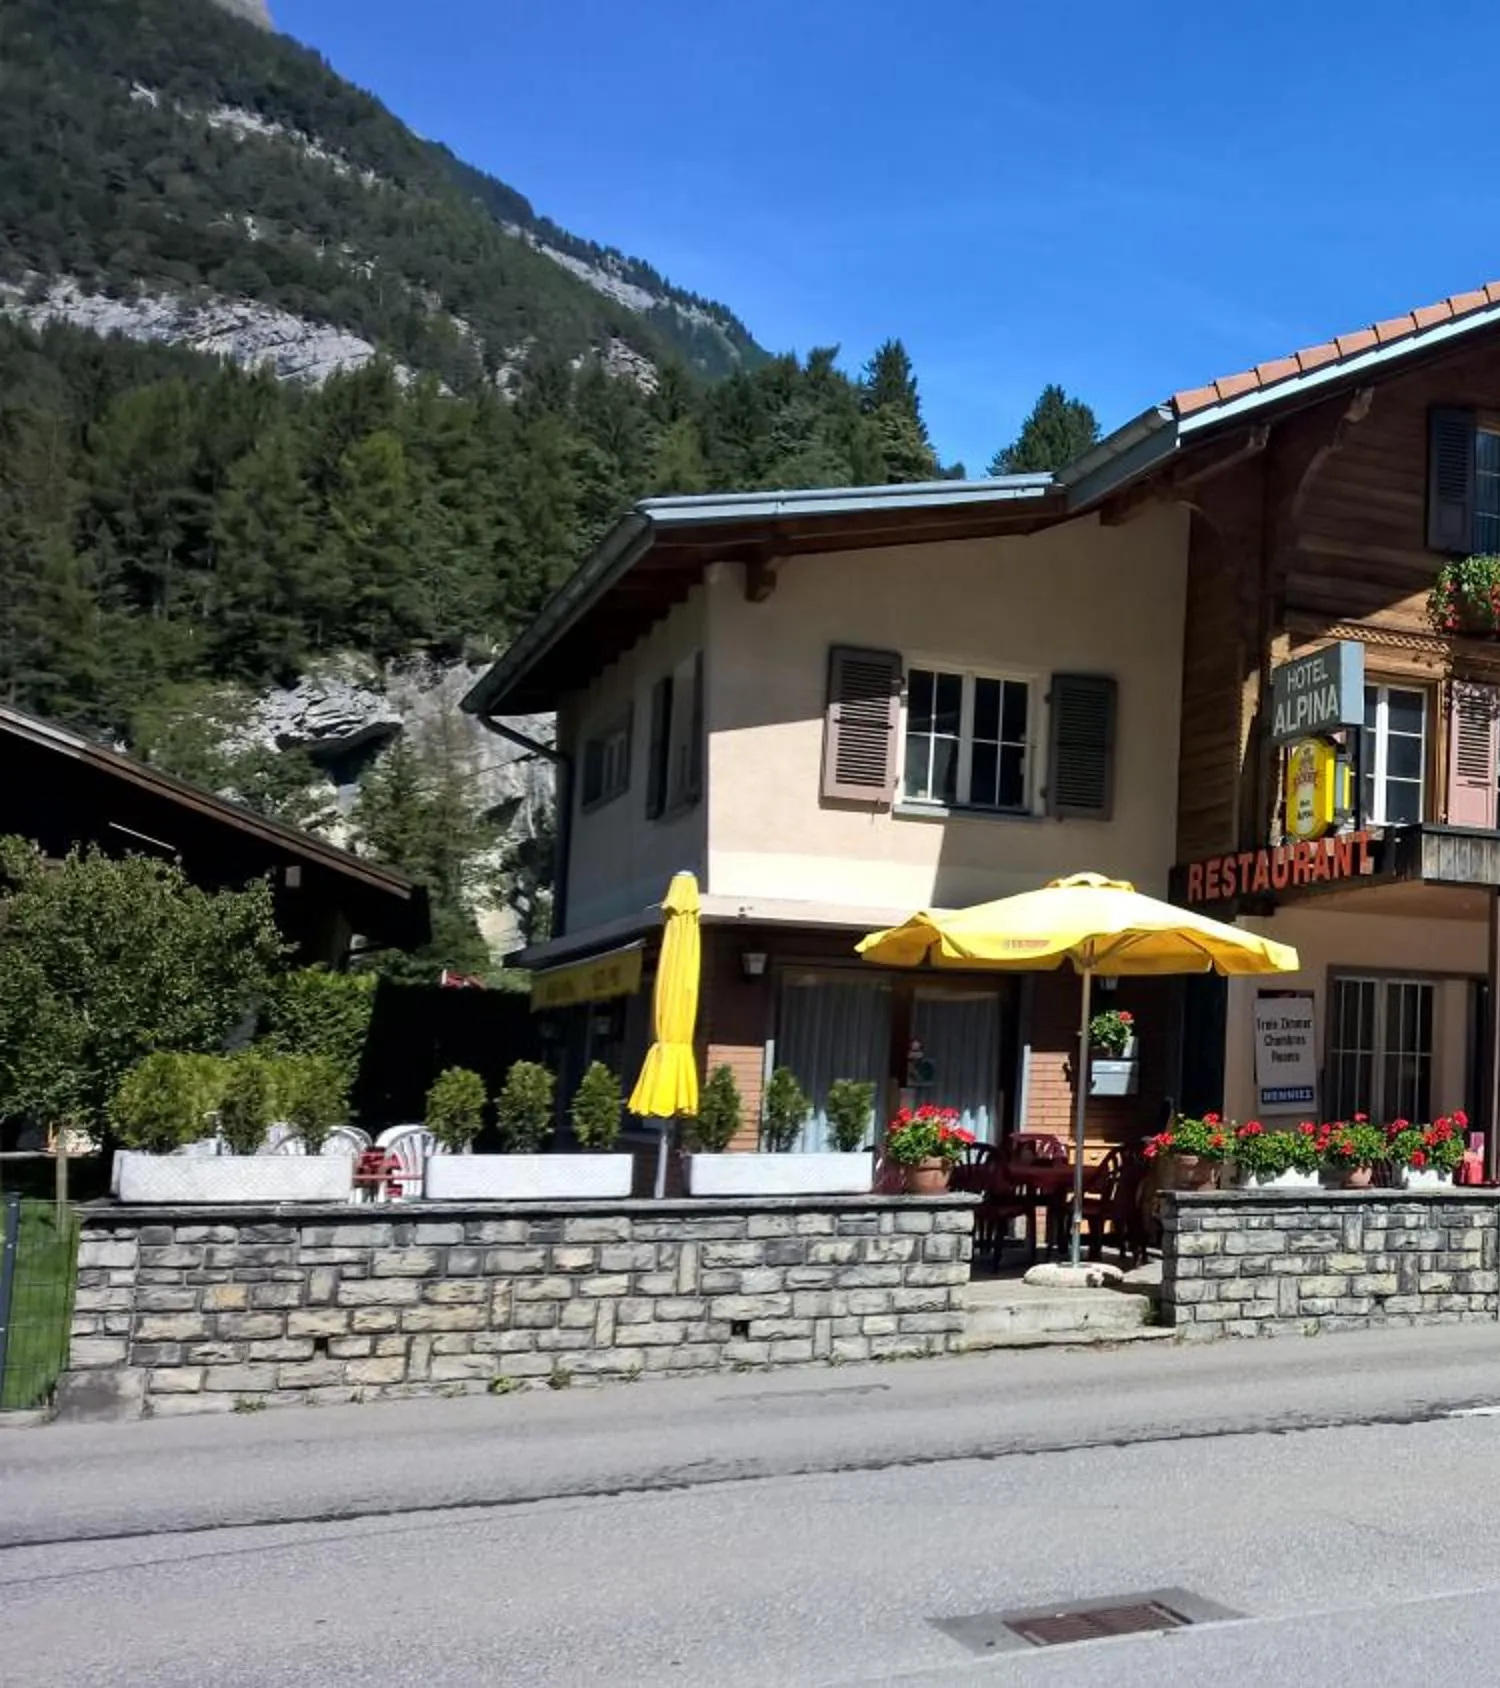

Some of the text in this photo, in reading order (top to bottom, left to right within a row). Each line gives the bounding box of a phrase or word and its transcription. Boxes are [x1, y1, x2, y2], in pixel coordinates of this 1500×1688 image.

[1287, 658, 1329, 695] HOTEL
[1273, 684, 1339, 737] ALPINA
[1188, 831, 1373, 903] RESTAURANT
